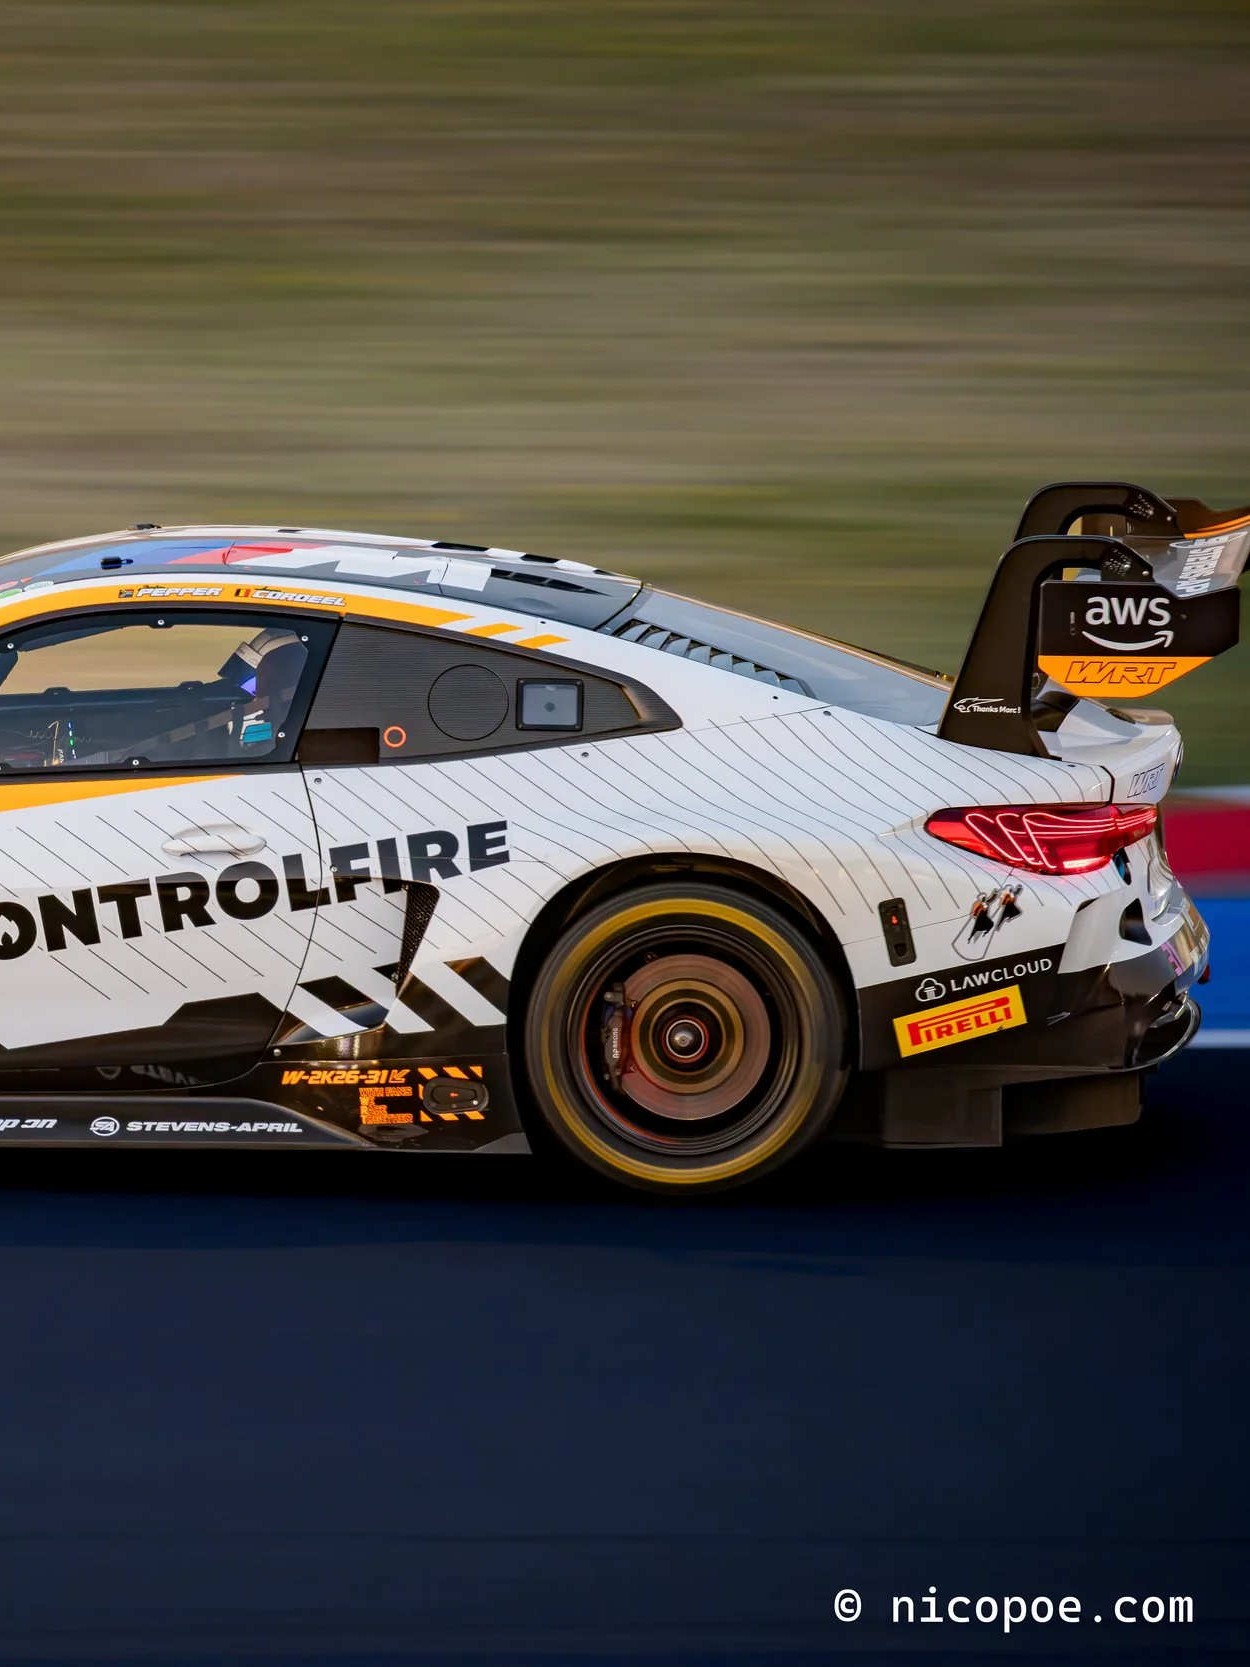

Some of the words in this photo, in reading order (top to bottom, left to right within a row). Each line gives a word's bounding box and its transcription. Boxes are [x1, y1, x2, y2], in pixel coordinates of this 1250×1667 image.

[1176, 545, 1225, 598] STEVENS-AP
[136, 587, 223, 598] PEPPER
[251, 590, 347, 607] CORDEEL
[1085, 596, 1171, 627] aws
[1064, 661, 1177, 684] WRT
[973, 705, 998, 713] Thanks
[1127, 762, 1165, 799] WRT
[951, 957, 1053, 992] LAWCLOUD
[906, 996, 1013, 1047] PIRELLI
[281, 1069, 388, 1085] W-2K26-31
[126, 1121, 304, 1133] STEVENS-APRIL
